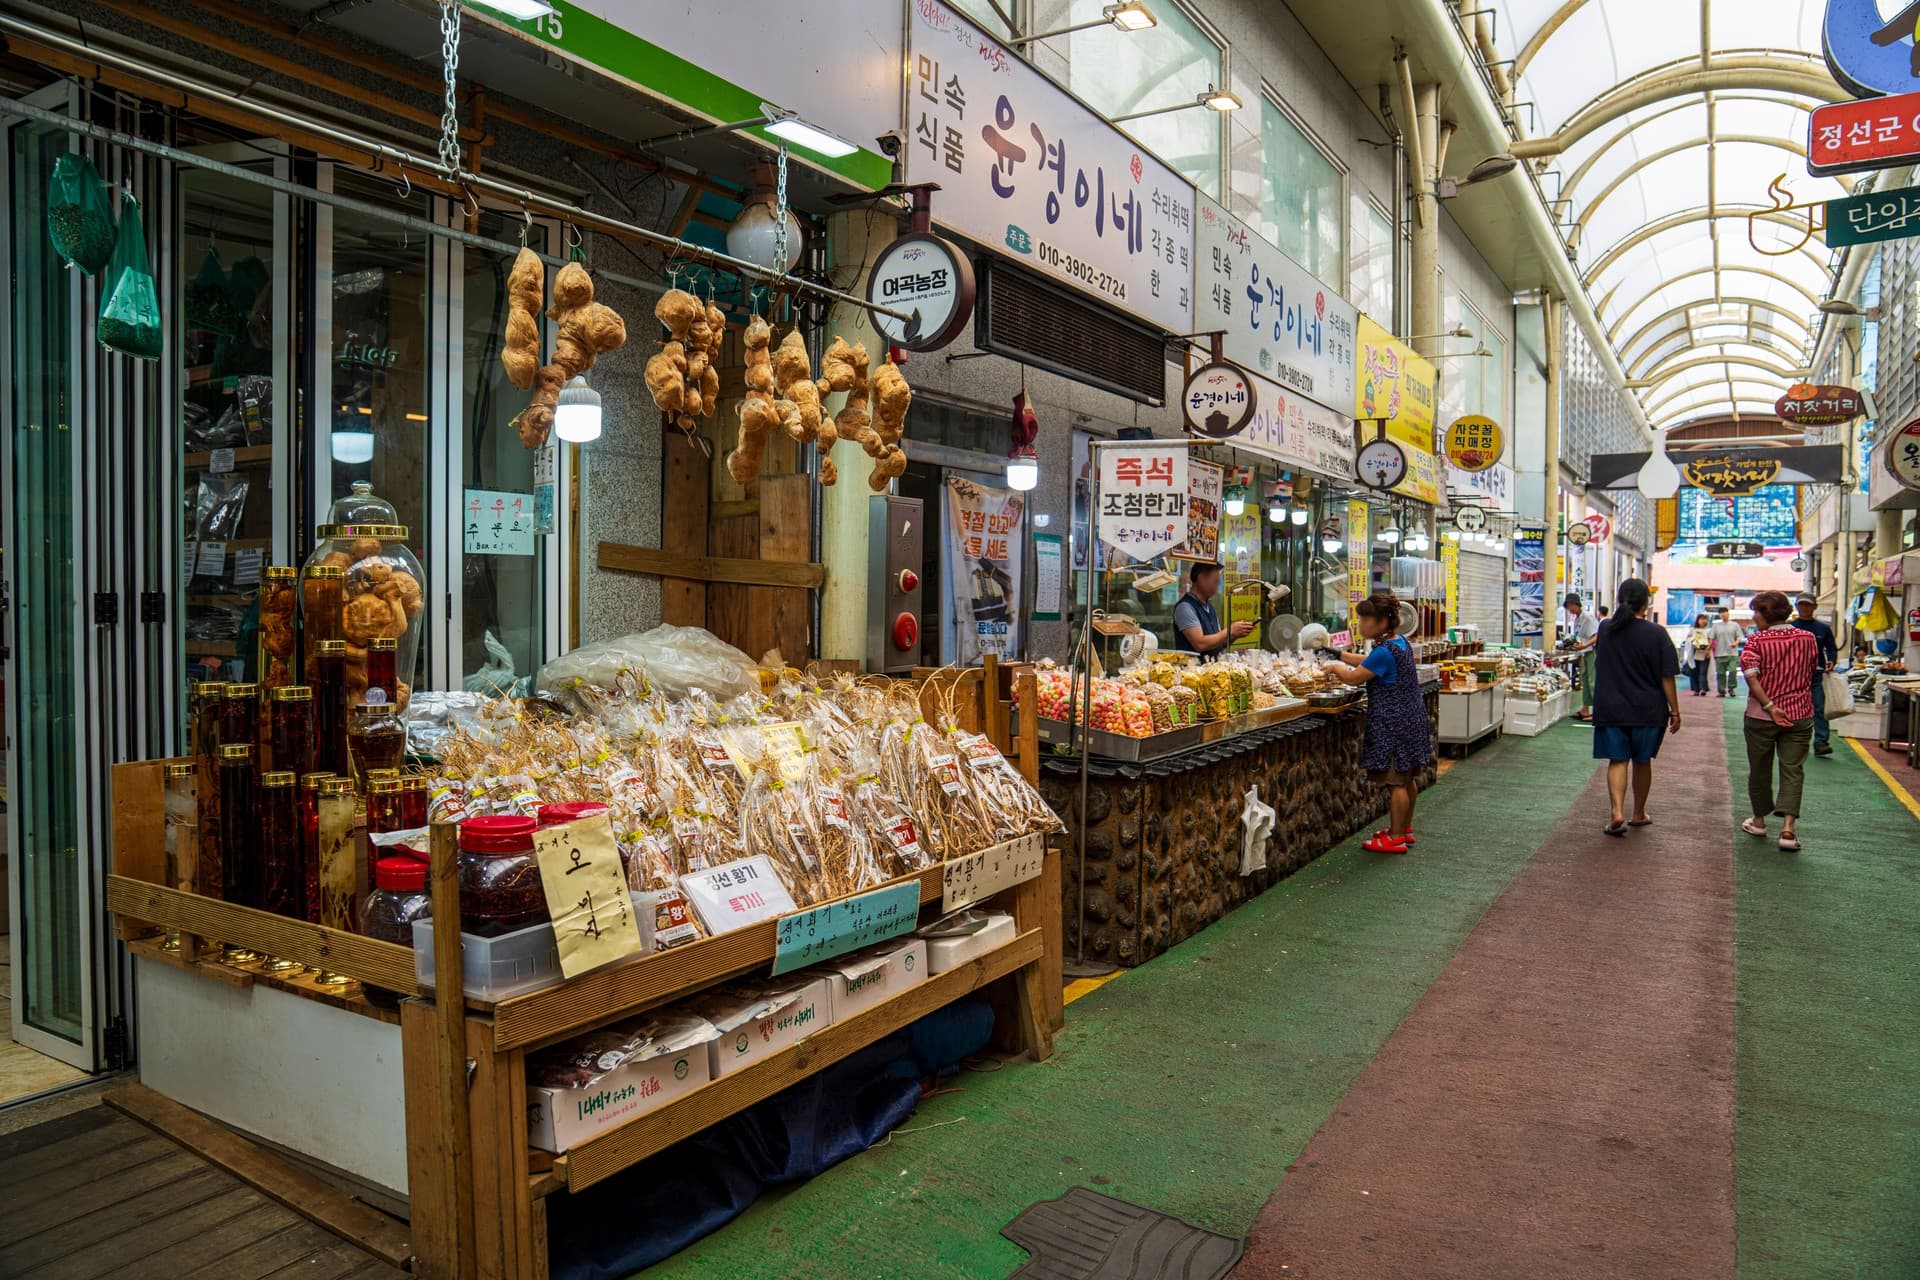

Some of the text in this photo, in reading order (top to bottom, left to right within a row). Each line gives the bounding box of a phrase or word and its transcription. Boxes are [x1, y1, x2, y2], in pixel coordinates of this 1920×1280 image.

[917, 53, 967, 121] 민속
[915, 111, 966, 175] 식품
[1818, 117, 1904, 151] 정선군
[981, 94, 1144, 255] 윤경이네
[1151, 186, 1190, 234] 수리취떡
[1008, 229, 1026, 249] 주문
[1038, 240, 1127, 301] 010-3902-2724
[1212, 246, 1233, 281] 민속
[882, 268, 949, 297] 여곡농장
[1212, 282, 1232, 316] 식품
[1246, 262, 1323, 358] 윤경이네
[1190, 391, 1245, 409] 윤경이네
[1784, 398, 1859, 413] 저잣거리
[1454, 436, 1493, 449] 직매장
[1455, 424, 1493, 436] 자연꿀
[1115, 457, 1174, 487] 즉석
[1103, 493, 1186, 517] 조청한과
[985, 539, 1008, 560] 세트
[1117, 527, 1173, 543] 윤경이네
[731, 864, 759, 884] 황기
[565, 848, 602, 940] 오미자
[728, 892, 765, 913] 특가!!
[794, 1002, 815, 1026] 시래기
